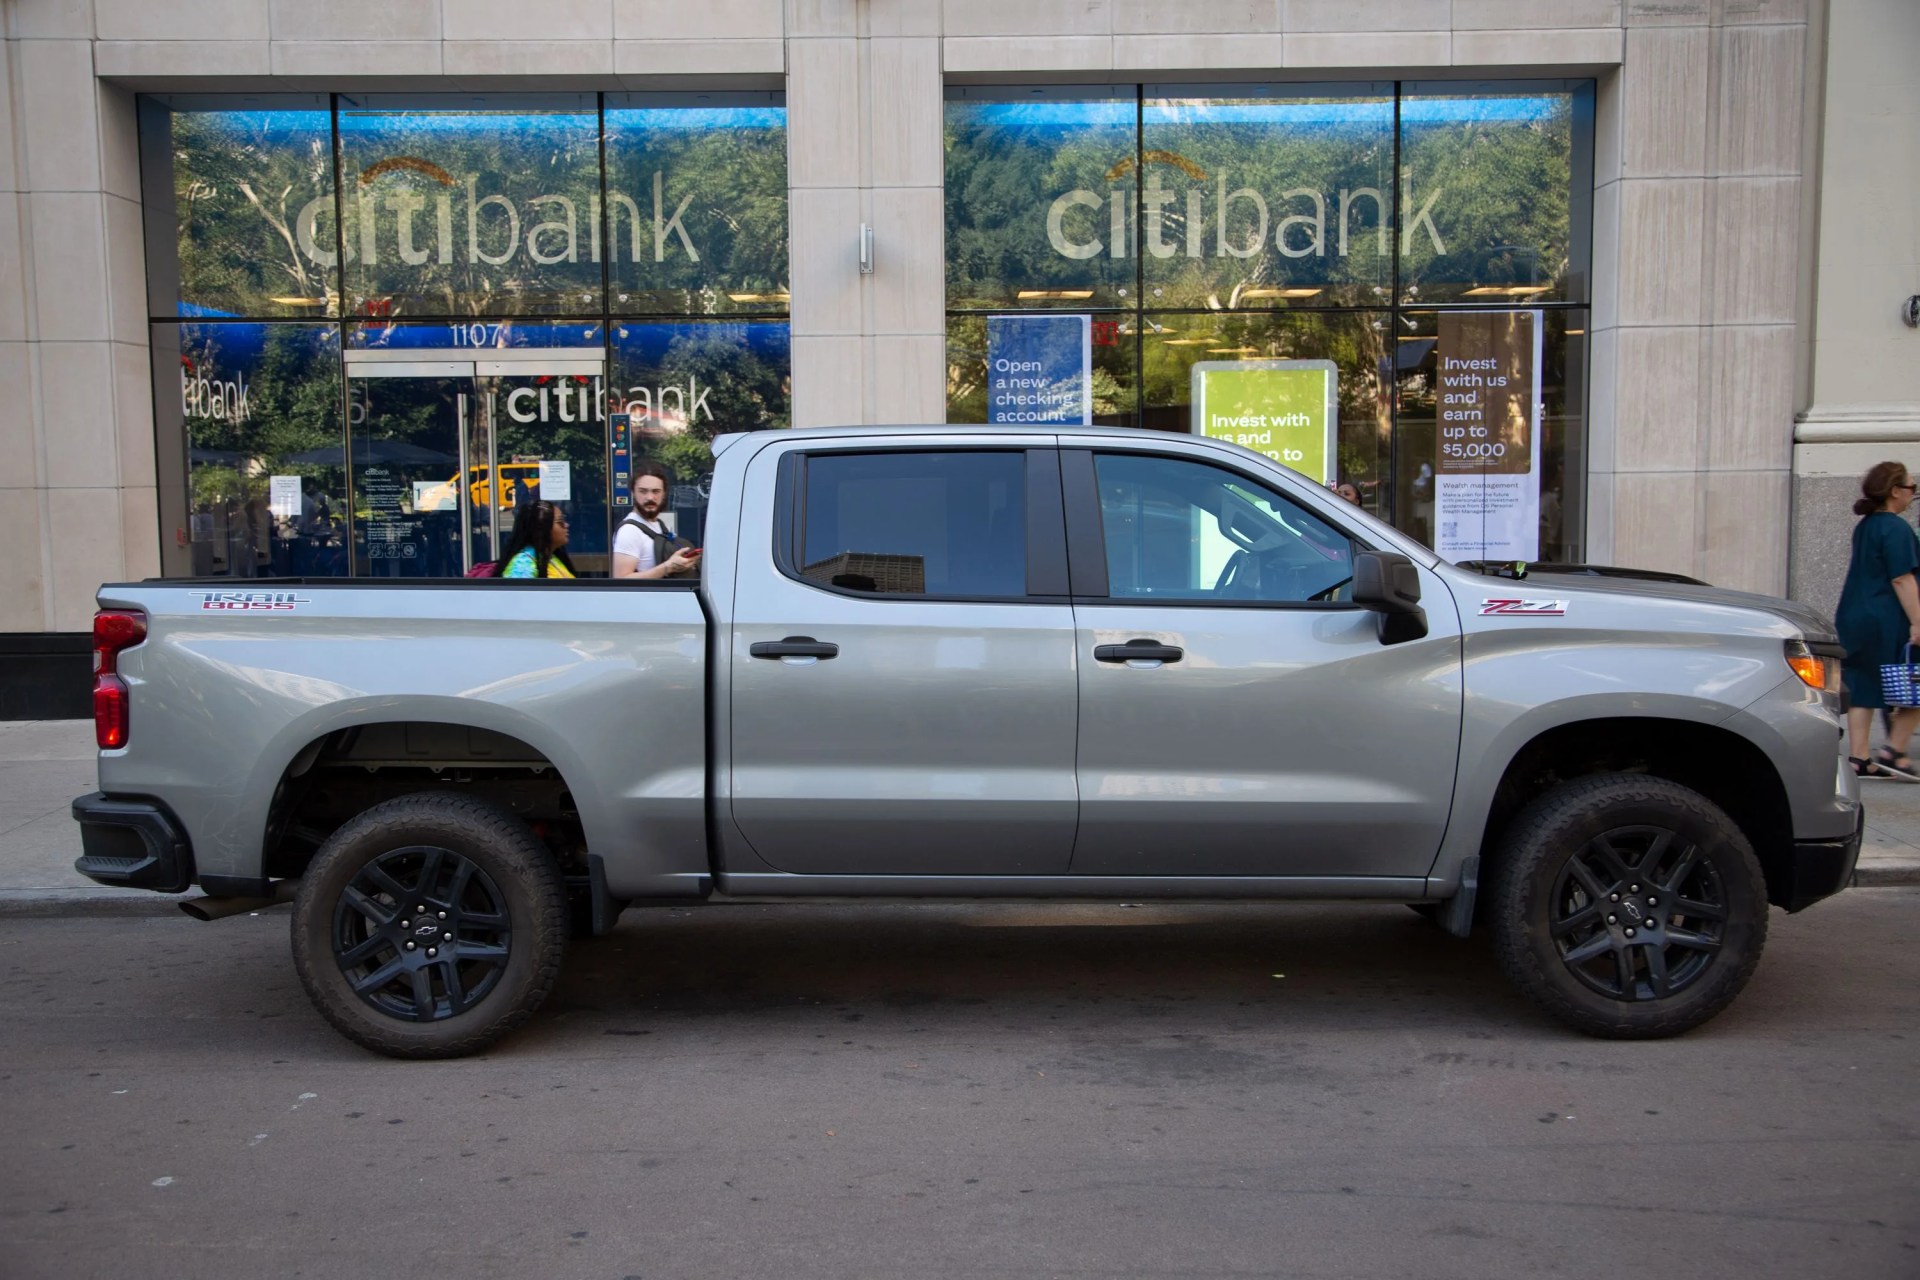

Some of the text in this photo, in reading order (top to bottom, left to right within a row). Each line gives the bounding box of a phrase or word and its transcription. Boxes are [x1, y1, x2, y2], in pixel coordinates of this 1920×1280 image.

[296, 170, 701, 266] citibank
[1046, 166, 1448, 261] citibank
[450, 324, 501, 346] 1107
[996, 359, 1041, 374] Open
[1445, 357, 1497, 370] Invest
[996, 378, 1046, 389] a new
[1444, 374, 1507, 387] with us
[507, 375, 714, 424] citibank
[996, 392, 1074, 407] checking
[1444, 391, 1477, 404] and
[996, 410, 1066, 422] account
[1212, 412, 1310, 427] Invest with
[1443, 409, 1482, 421] earn
[1237, 430, 1271, 445] and
[1443, 426, 1488, 440] up to
[1283, 448, 1303, 461] to
[1443, 443, 1505, 458] $5,000
[191, 592, 311, 603] TRAIL
[202, 601, 295, 610] BOSS
[1478, 599, 1570, 616] Z71
